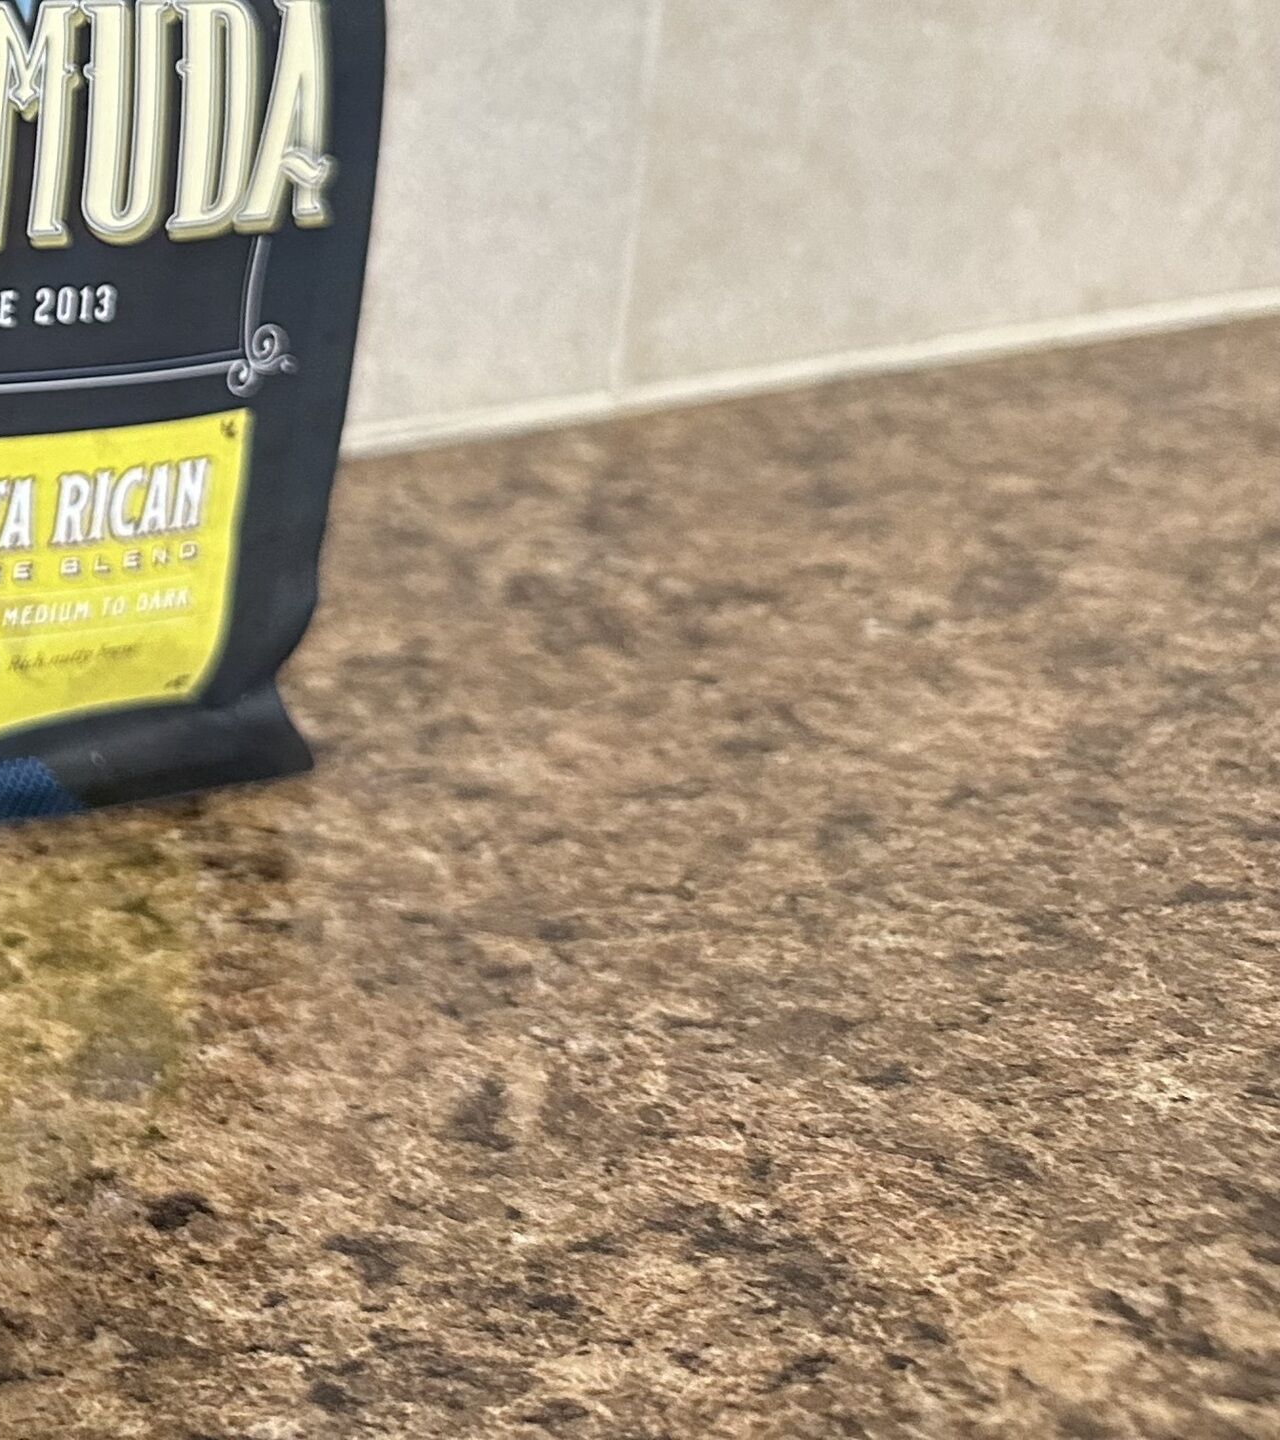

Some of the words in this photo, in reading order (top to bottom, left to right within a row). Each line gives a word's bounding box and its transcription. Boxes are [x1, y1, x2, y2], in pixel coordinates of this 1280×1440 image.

[33, 283, 120, 325] 2013
[48, 457, 214, 548] RICAN
[59, 541, 198, 578] BLEND
[0, 599, 90, 629] MEDIUM
[100, 593, 126, 617] TO
